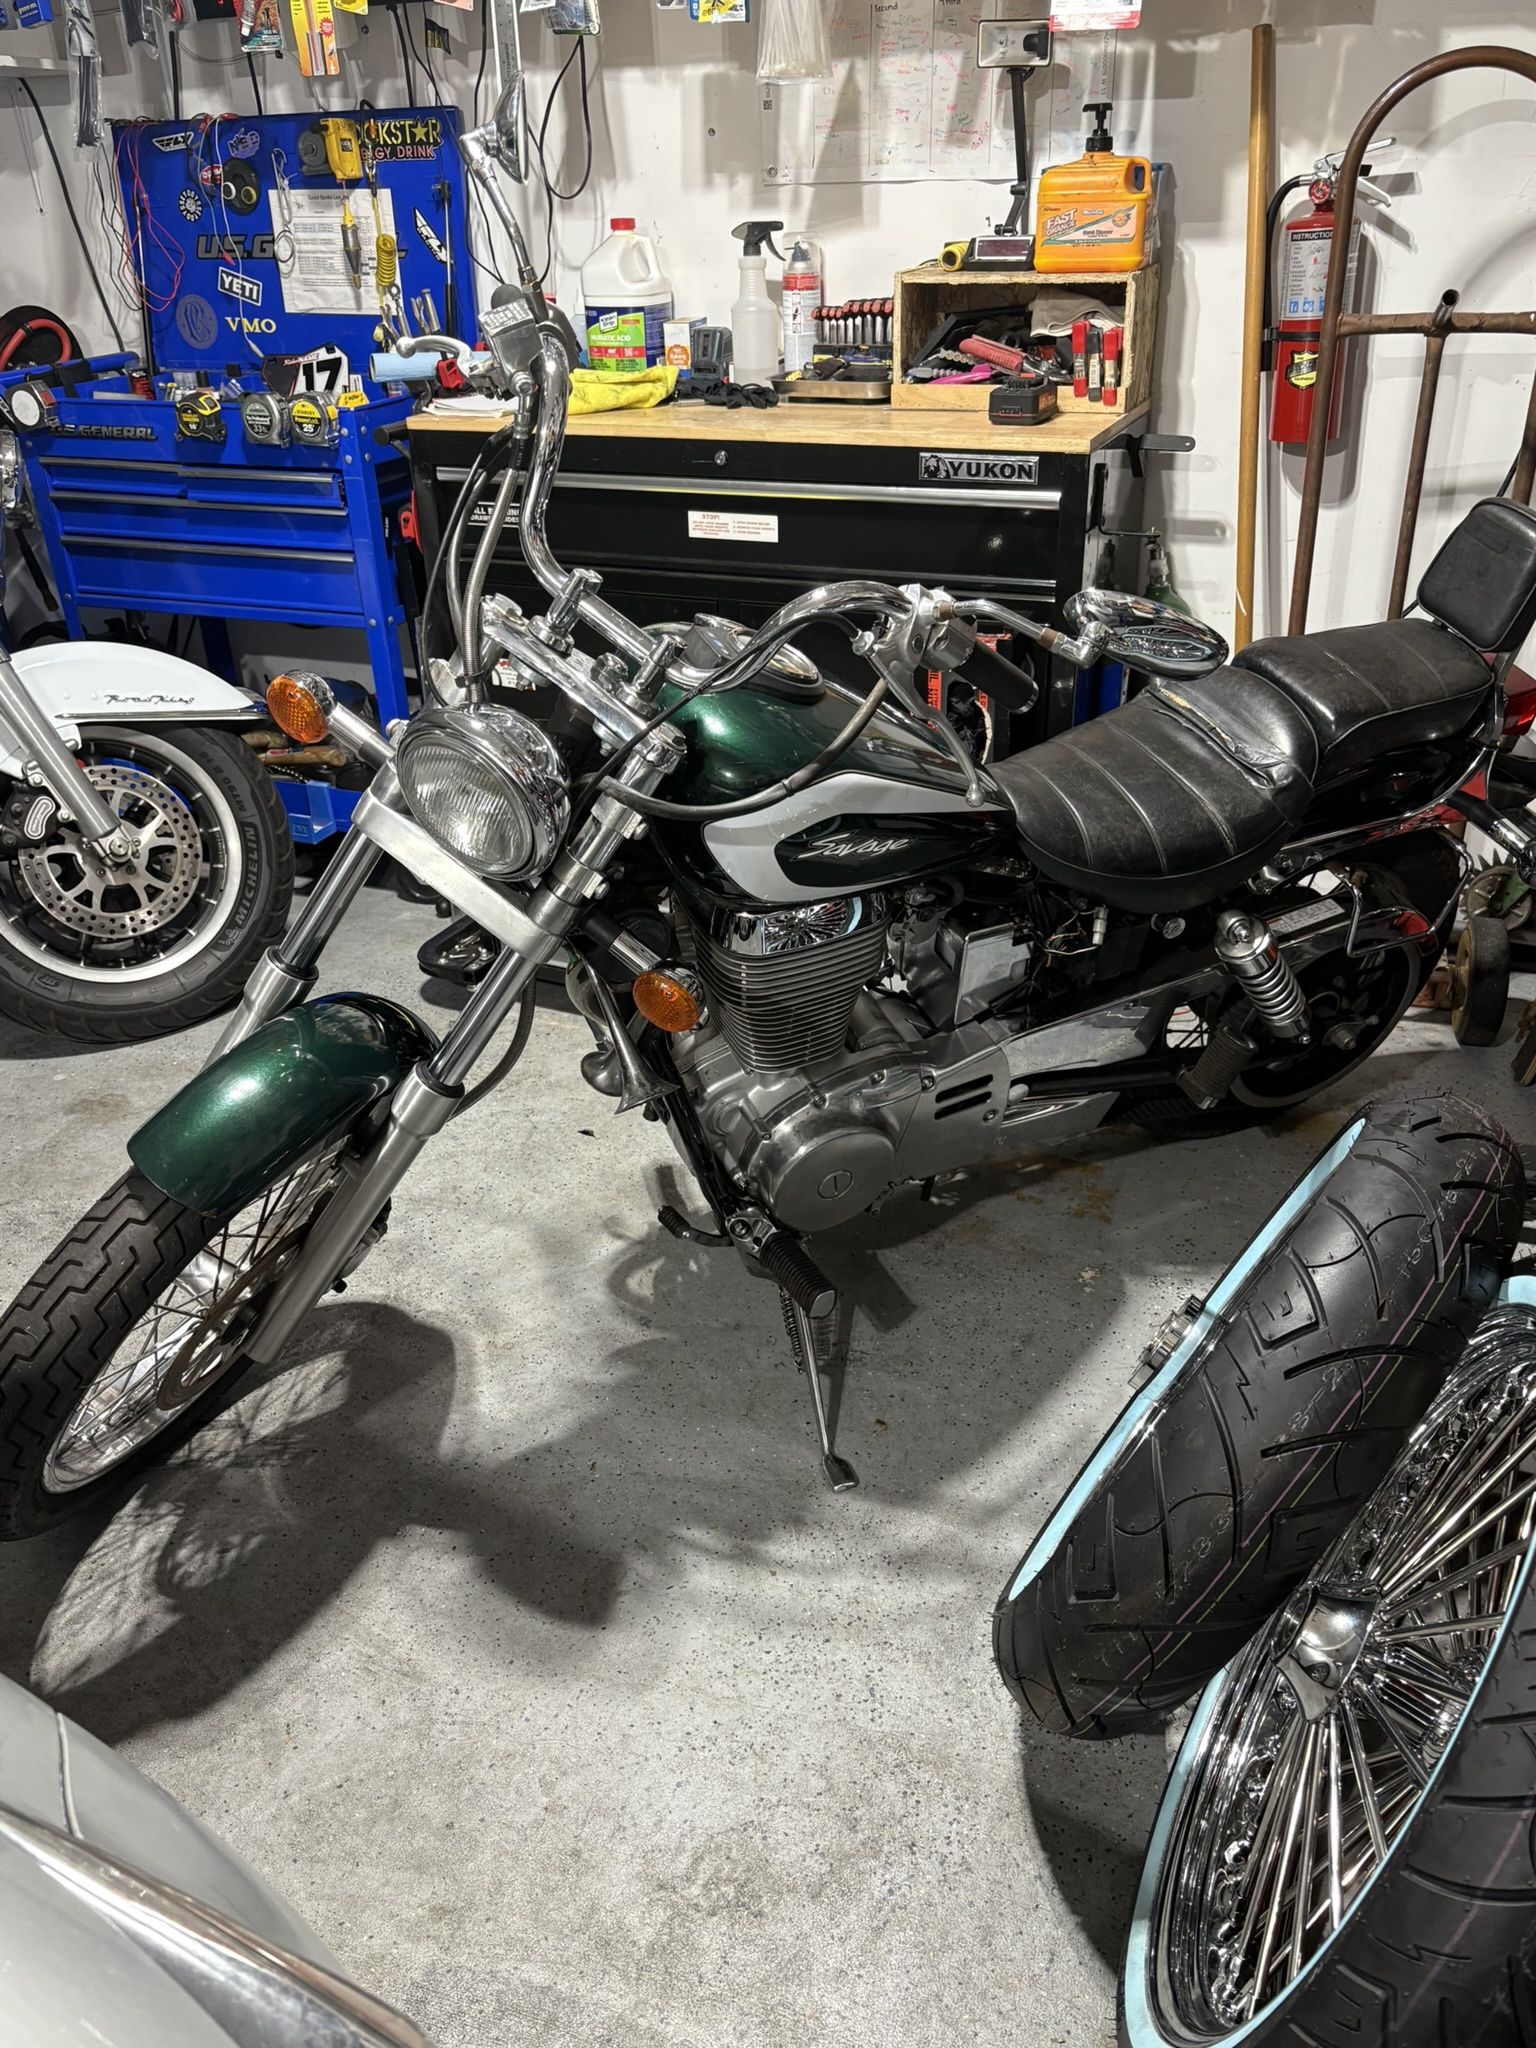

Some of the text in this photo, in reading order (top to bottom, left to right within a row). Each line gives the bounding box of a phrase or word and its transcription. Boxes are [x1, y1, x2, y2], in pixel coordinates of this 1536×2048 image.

[874, 3, 899, 12] Second
[355, 117, 442, 146] OCKSTAR
[396, 145, 434, 159] DRINK
[1046, 208, 1078, 230] FAST
[1046, 220, 1077, 236] ORANGE
[221, 272, 259, 300] YETI
[225, 317, 276, 333] VMO
[302, 356, 342, 393] 17
[78, 424, 157, 441] GENERAL
[948, 460, 1033, 480] YUKON
[793, 830, 913, 859] Savage
[235, 825, 260, 926] MICHELIN
